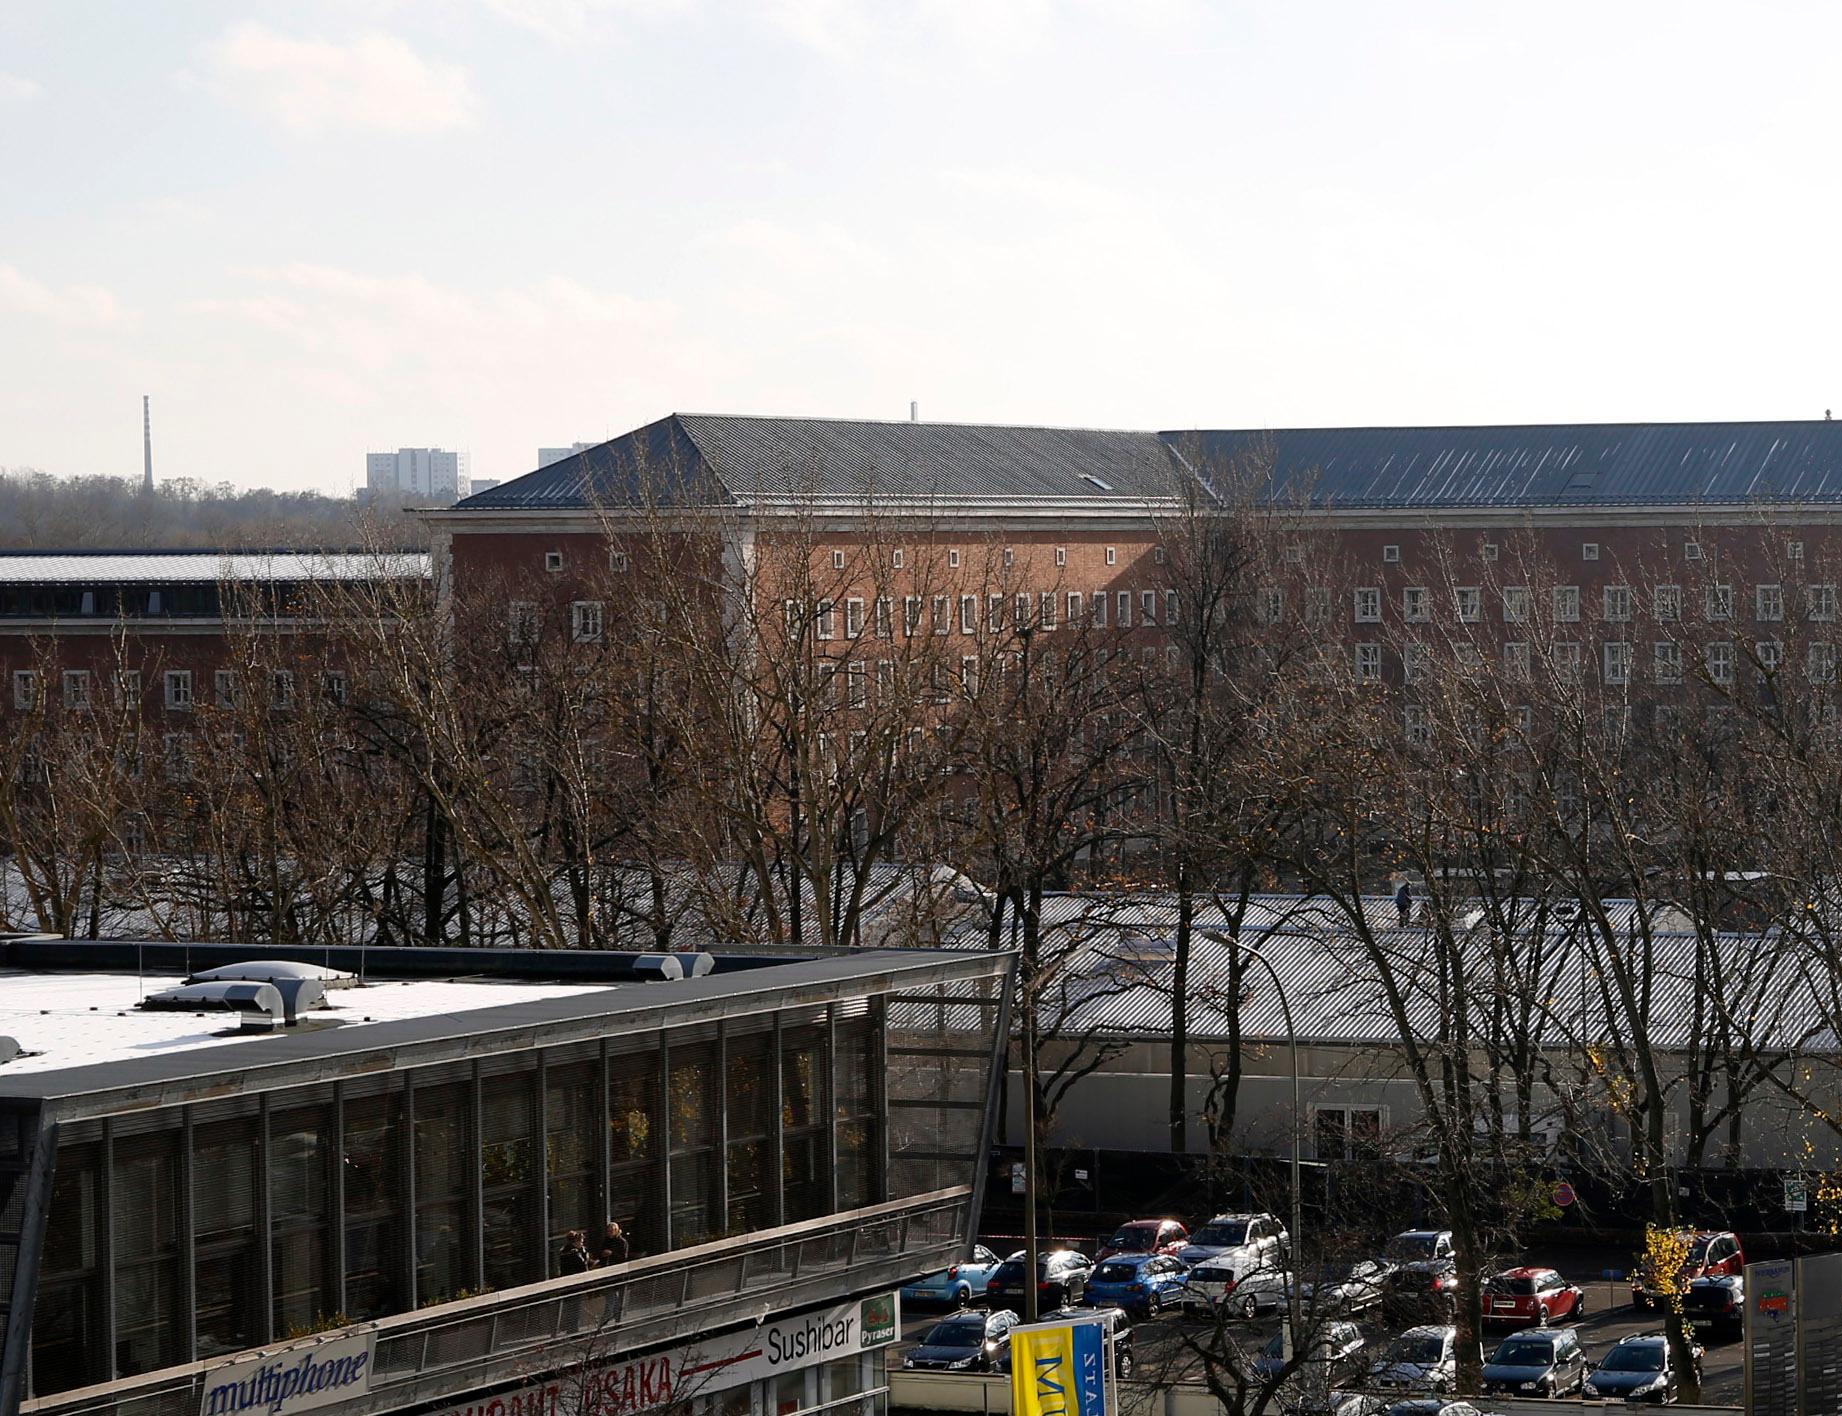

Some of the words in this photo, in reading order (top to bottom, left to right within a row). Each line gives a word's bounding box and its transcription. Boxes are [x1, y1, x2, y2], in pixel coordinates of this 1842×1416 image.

[768, 1316, 854, 1365] Sushibar
[861, 1326, 894, 1344] Pyraser
[207, 1351, 369, 1416] multiphone
